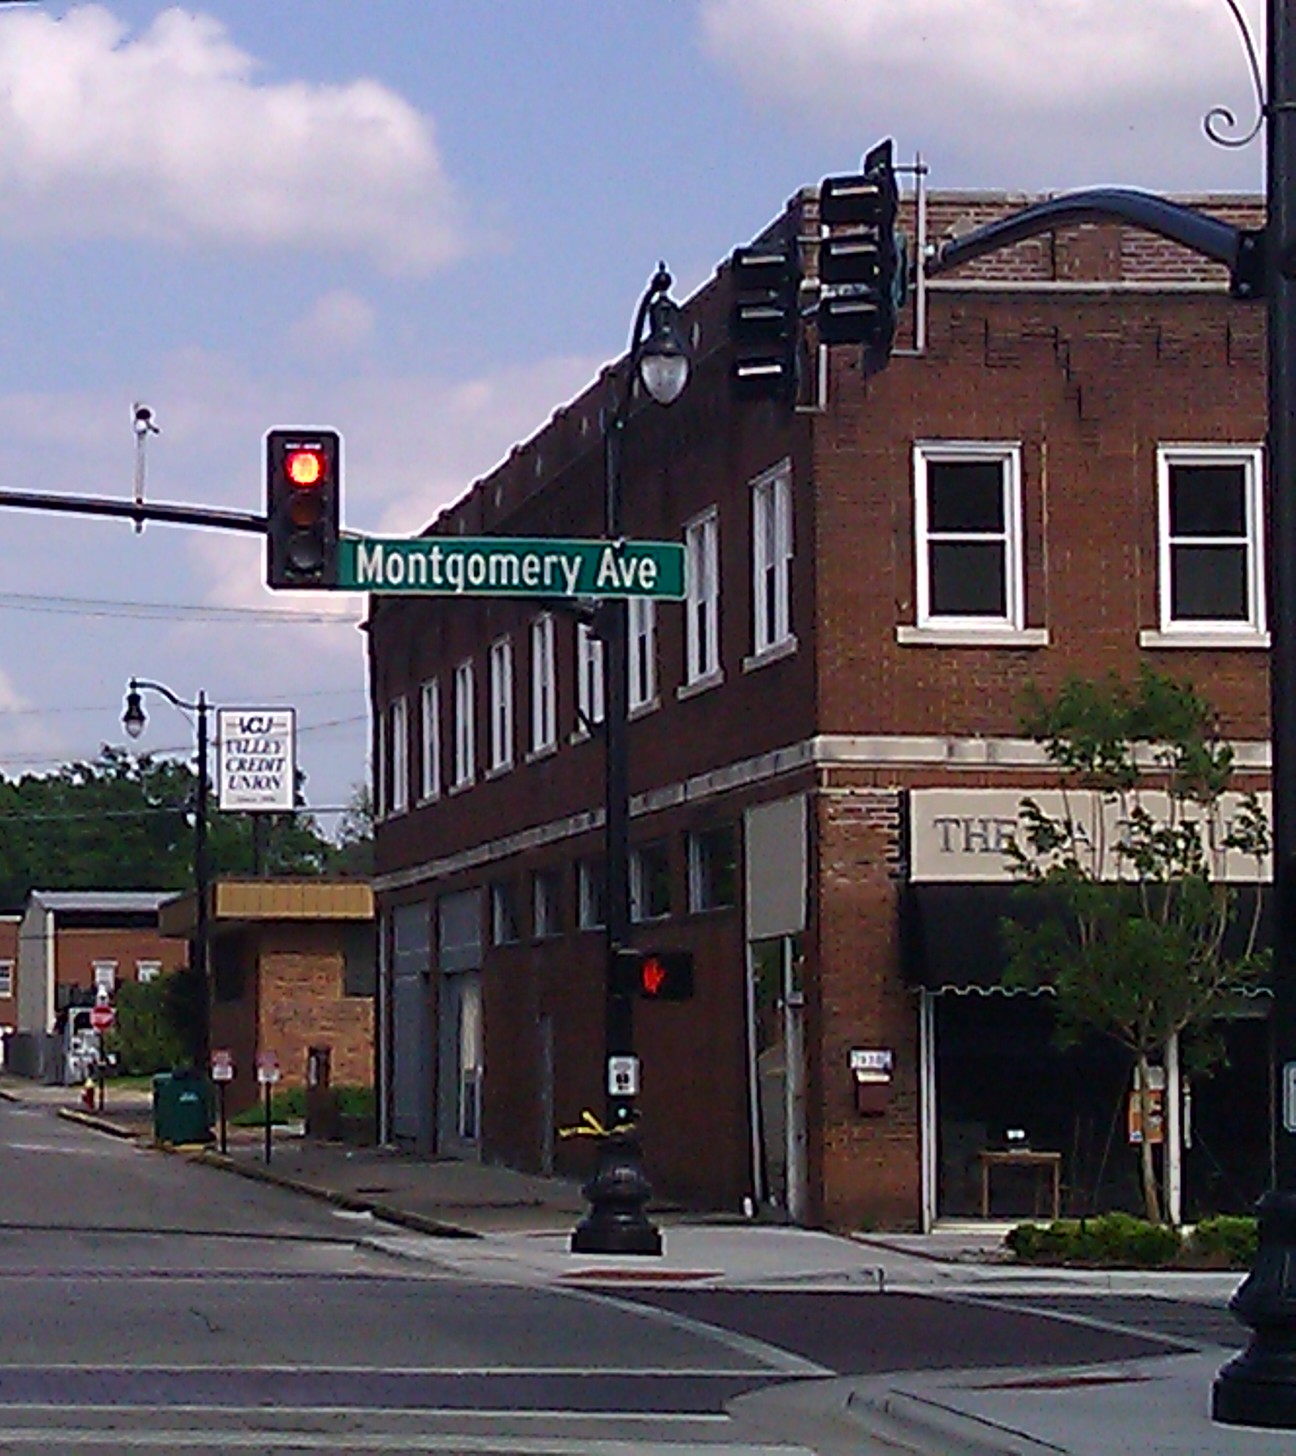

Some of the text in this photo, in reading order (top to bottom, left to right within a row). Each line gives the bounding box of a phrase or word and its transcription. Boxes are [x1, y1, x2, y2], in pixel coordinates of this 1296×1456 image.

[357, 543, 657, 595] Montgomery Ave
[225, 757, 286, 772] CREDIT
[228, 775, 281, 790] UNION
